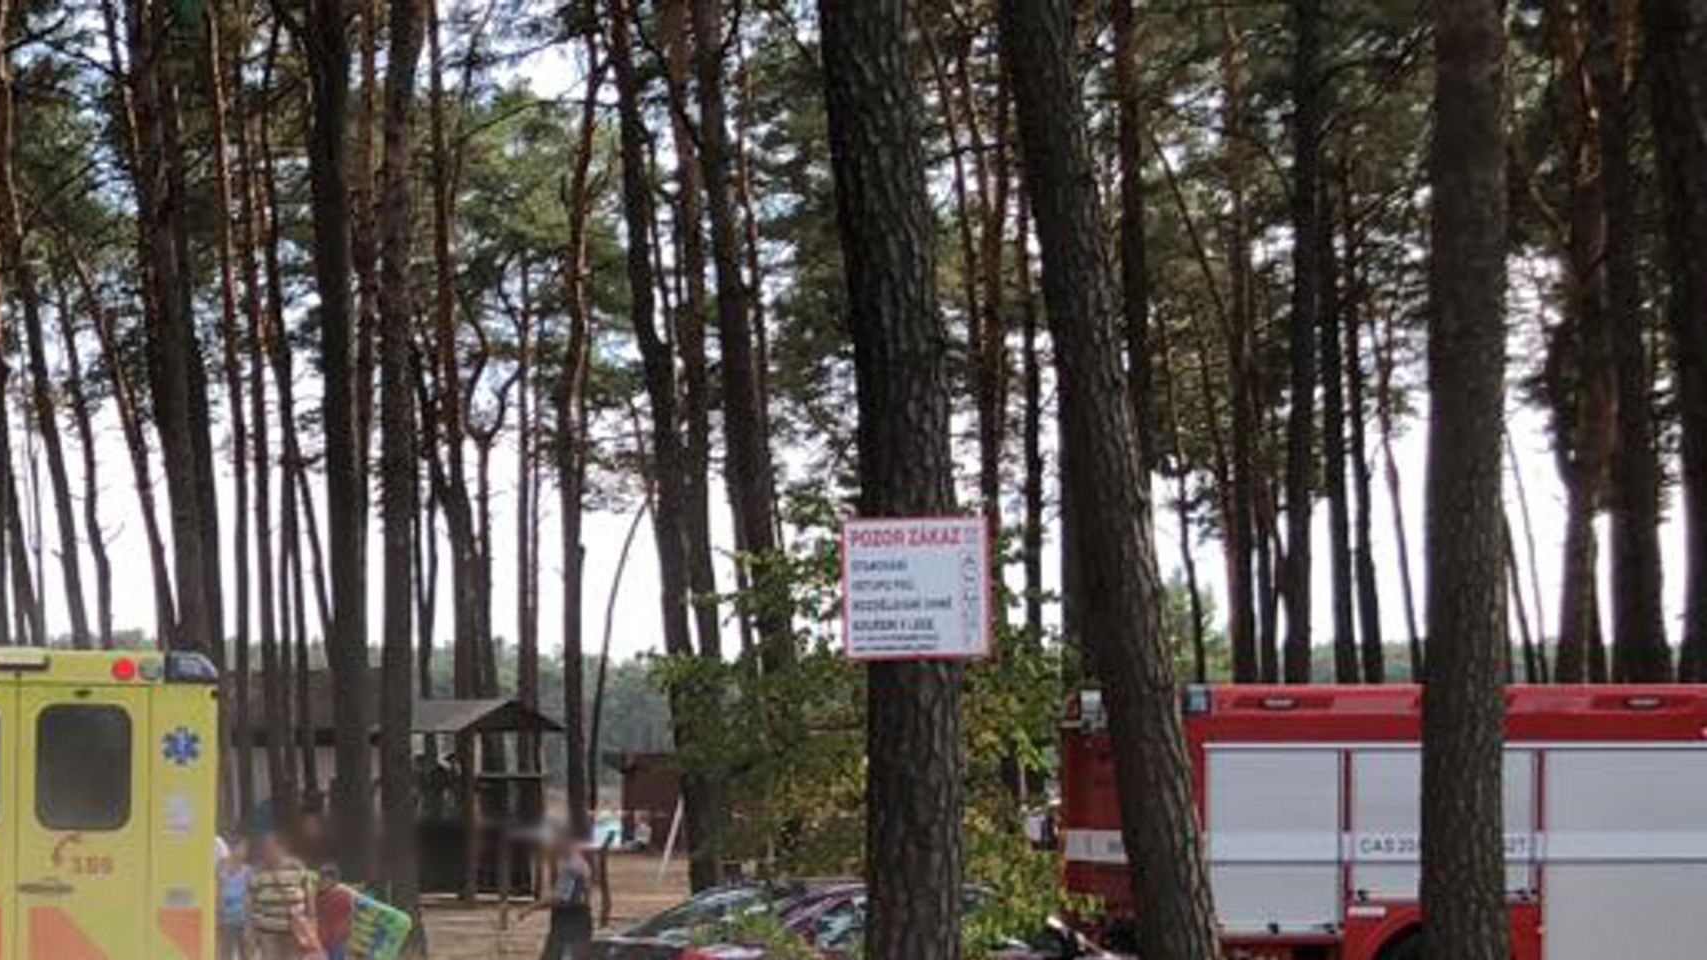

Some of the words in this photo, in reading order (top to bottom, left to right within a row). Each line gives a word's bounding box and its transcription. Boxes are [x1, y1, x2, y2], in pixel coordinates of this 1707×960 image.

[851, 529, 906, 547] POZOR
[908, 523, 960, 546] ZÁKAZ
[1360, 838, 1395, 853] CAS
